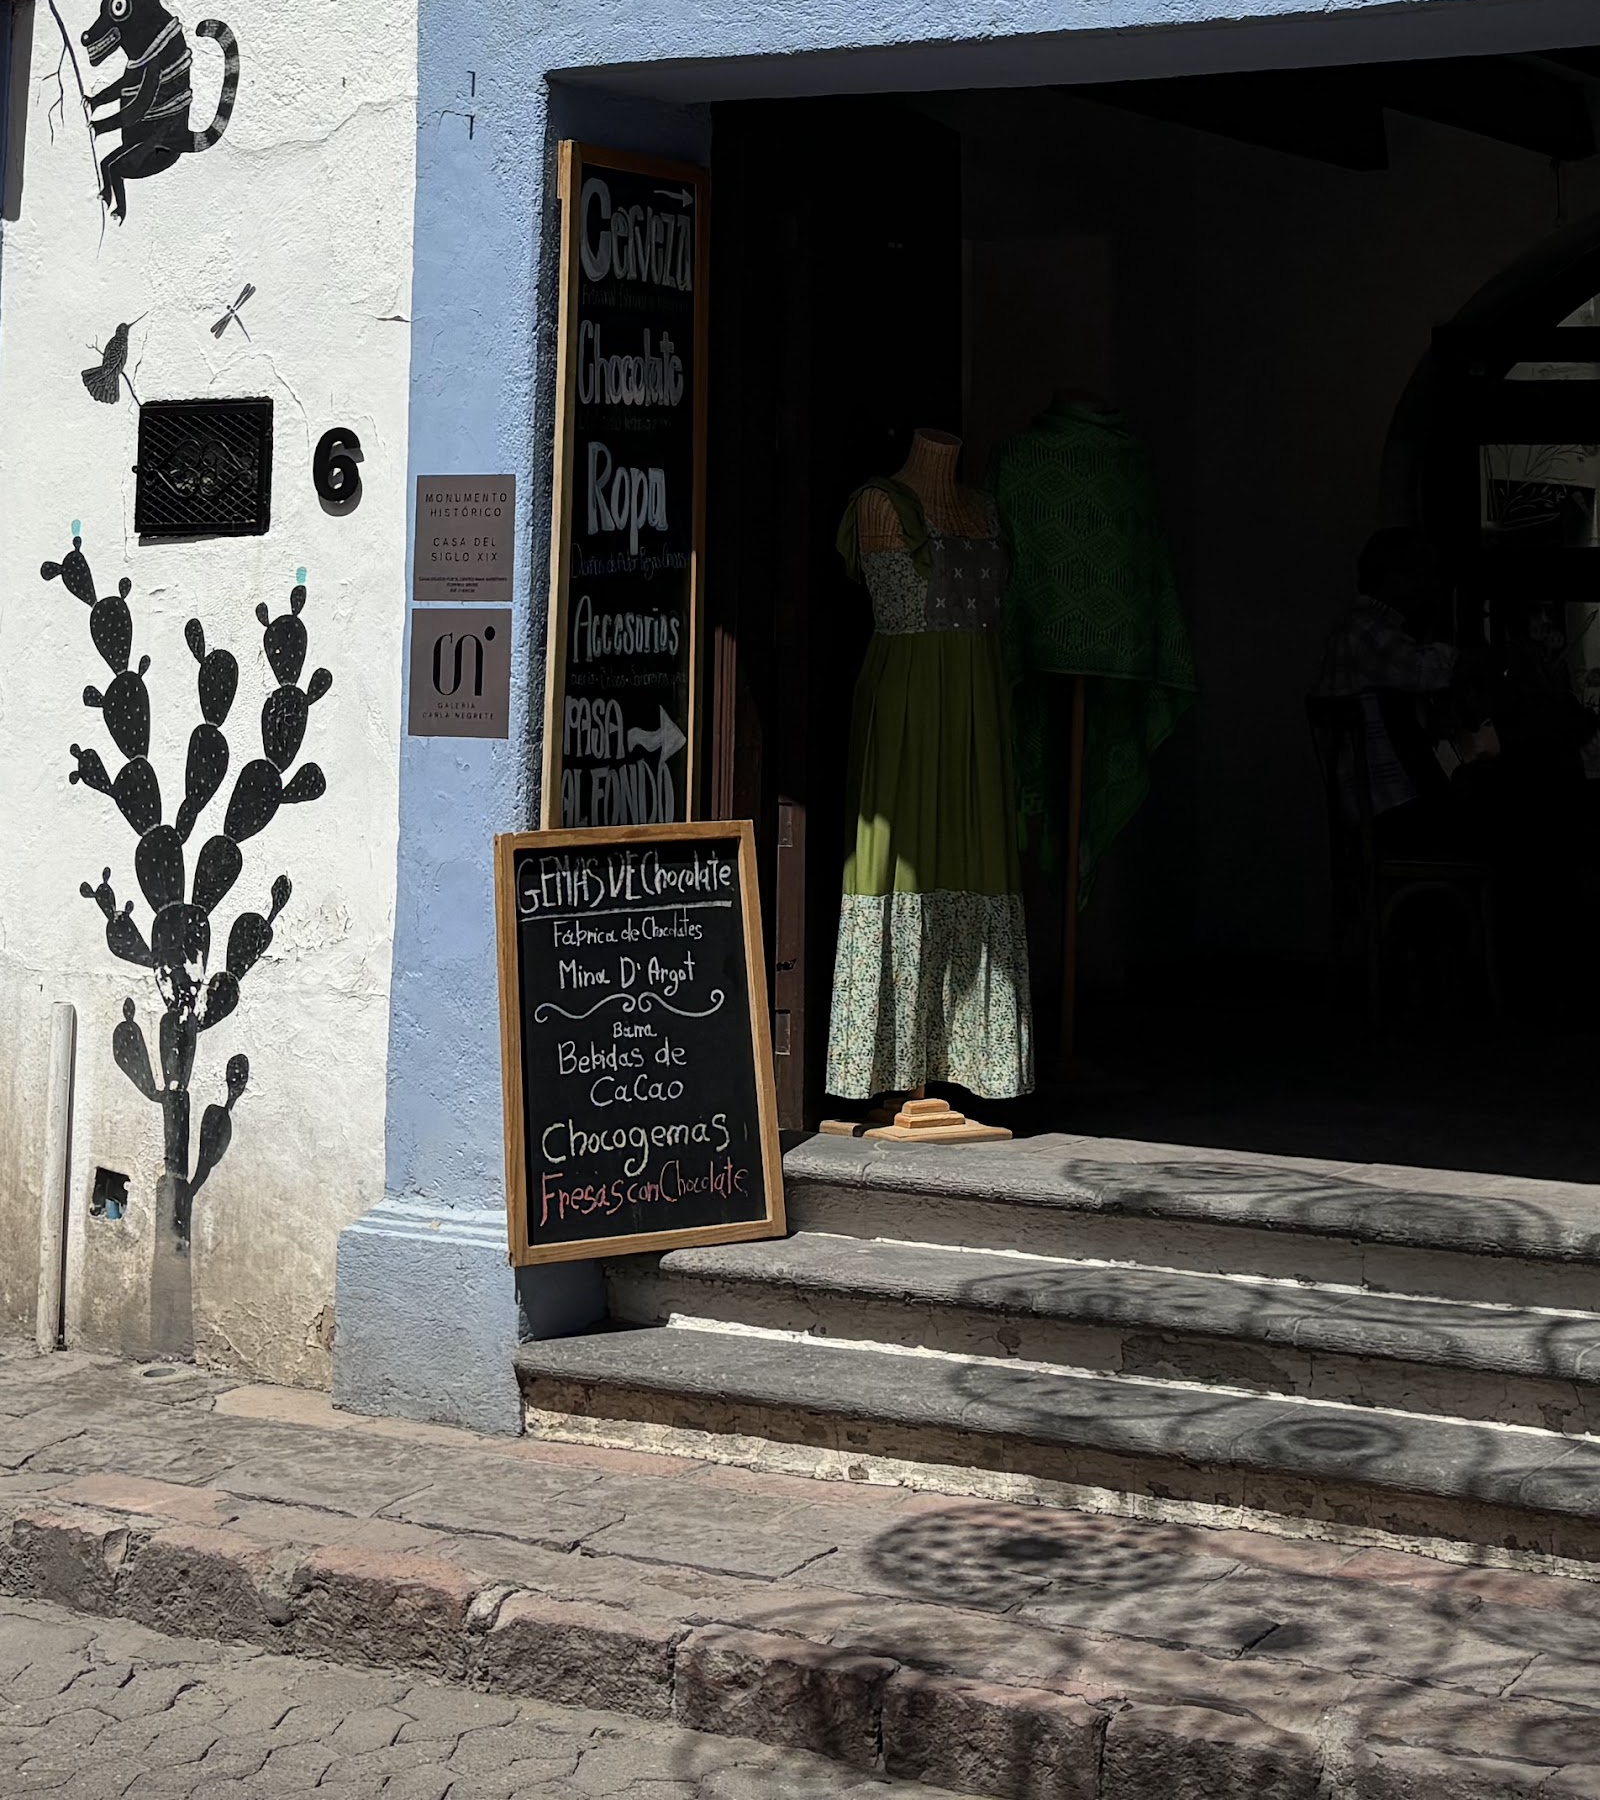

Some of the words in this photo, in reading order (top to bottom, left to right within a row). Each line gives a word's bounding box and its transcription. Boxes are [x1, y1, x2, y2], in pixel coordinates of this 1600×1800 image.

[580, 177, 692, 292] Cerveza
[578, 320, 684, 407] Chocolate
[312, 427, 362, 502] 6
[425, 493, 508, 503] MONUMENTO
[430, 506, 502, 517] HISTÓRICO
[587, 441, 668, 556] Ropa
[431, 552, 470, 562] SIGLO
[477, 552, 498, 561] XIX
[433, 537, 466, 547] CASA
[474, 537, 496, 547] DEL
[573, 595, 680, 663] Accesorios
[455, 712, 494, 720] NEGRETE
[564, 695, 626, 760] PASA
[562, 768, 589, 827] AL
[590, 758, 675, 826] FONDO
[517, 855, 605, 914] GEMAS
[608, 851, 642, 900] DE
[641, 848, 732, 895] Chocolate
[621, 917, 640, 942] de
[642, 907, 703, 940] Chocolates
[559, 958, 611, 989] Mina
[558, 1040, 644, 1075] Bebidas
[655, 1037, 687, 1067] de
[540, 1172, 624, 1227] Fresas
[627, 1181, 659, 1203] con
[660, 1156, 749, 1202] Chocolate
